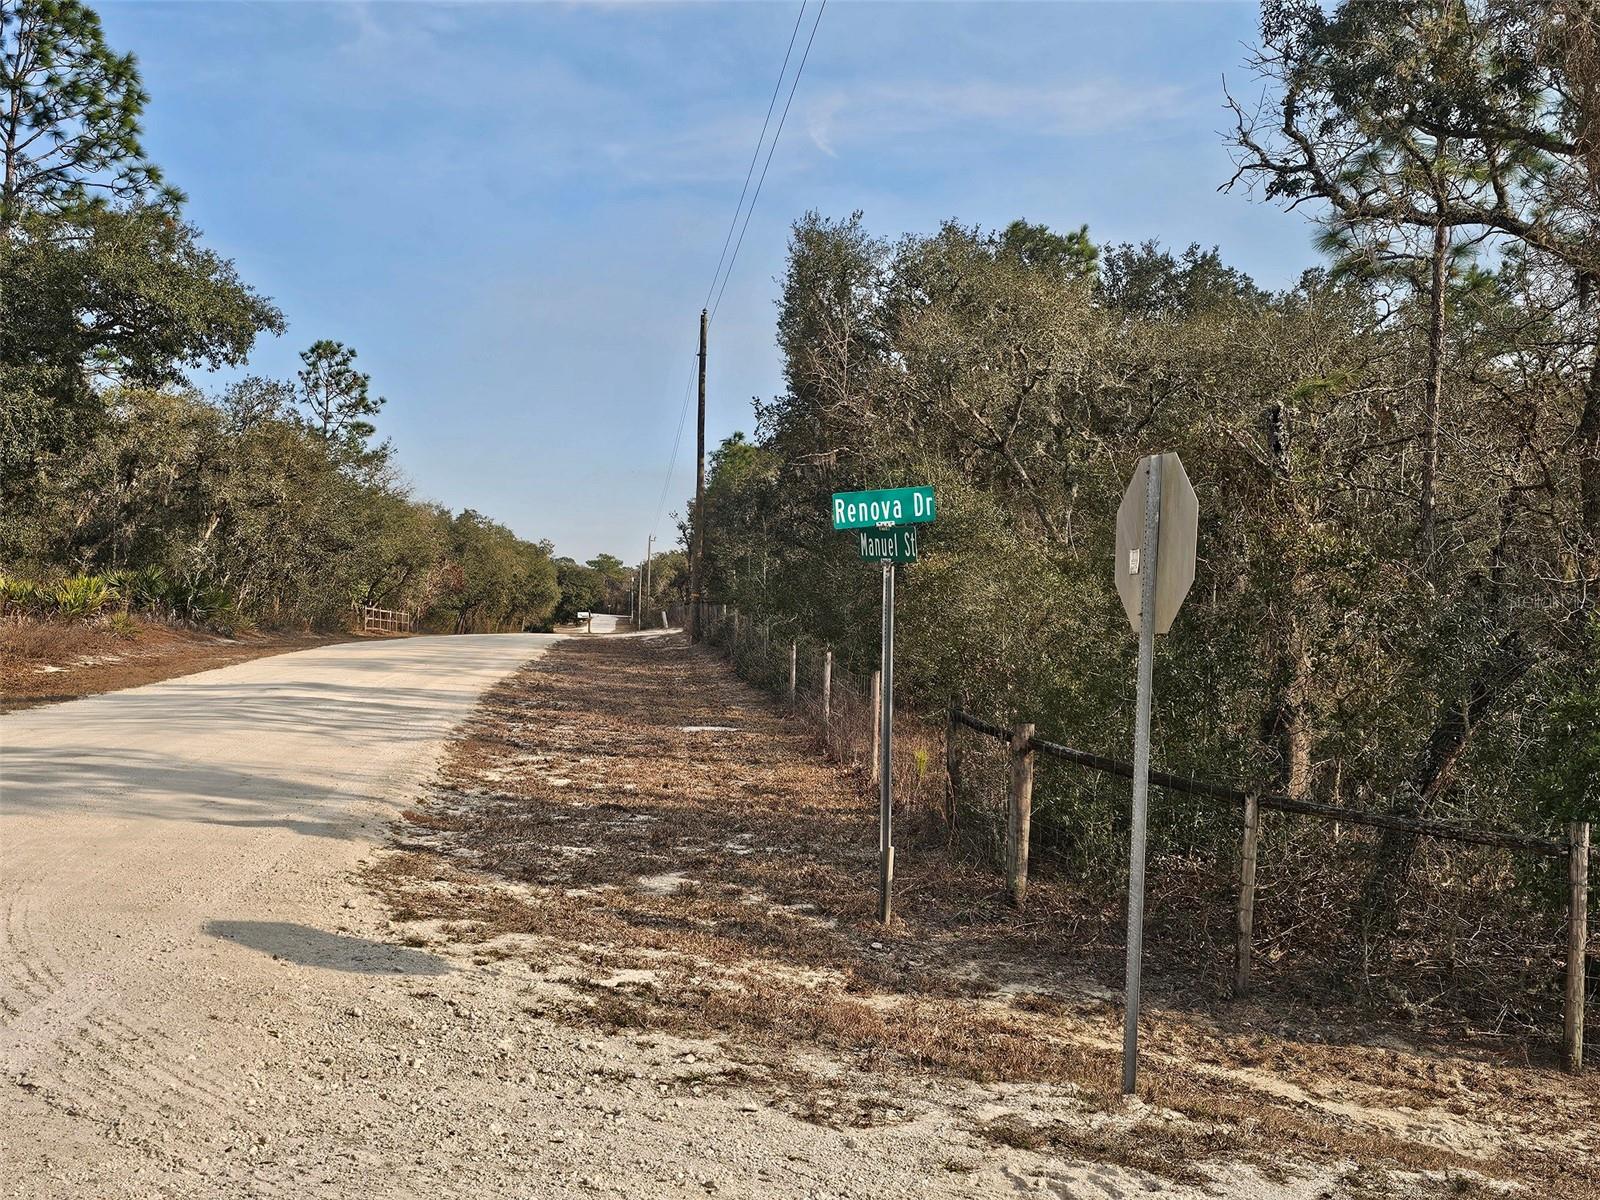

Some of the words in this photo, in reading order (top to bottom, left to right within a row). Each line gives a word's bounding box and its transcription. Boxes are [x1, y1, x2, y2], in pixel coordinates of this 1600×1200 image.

[834, 498, 902, 524] Renova
[913, 492, 933, 517] Dr
[860, 532, 898, 557] Manuel
[904, 531, 916, 557] St
